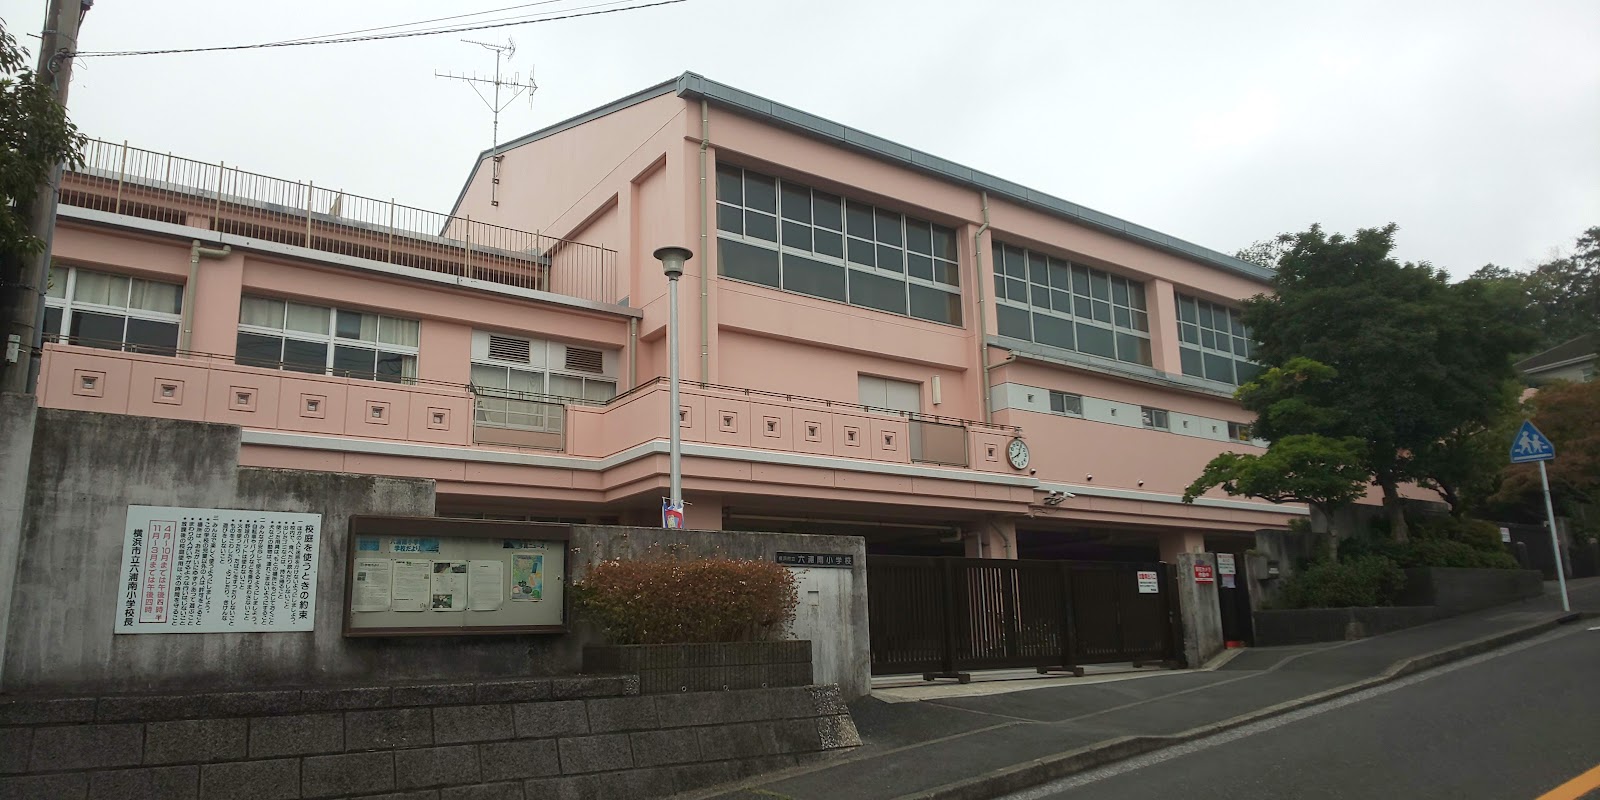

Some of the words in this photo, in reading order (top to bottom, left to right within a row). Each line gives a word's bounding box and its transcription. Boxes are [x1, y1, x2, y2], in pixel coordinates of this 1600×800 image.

[123, 529, 143, 627] 横浜市立六浦南小学校長
[299, 525, 314, 620] 校庭を使うときの約束
